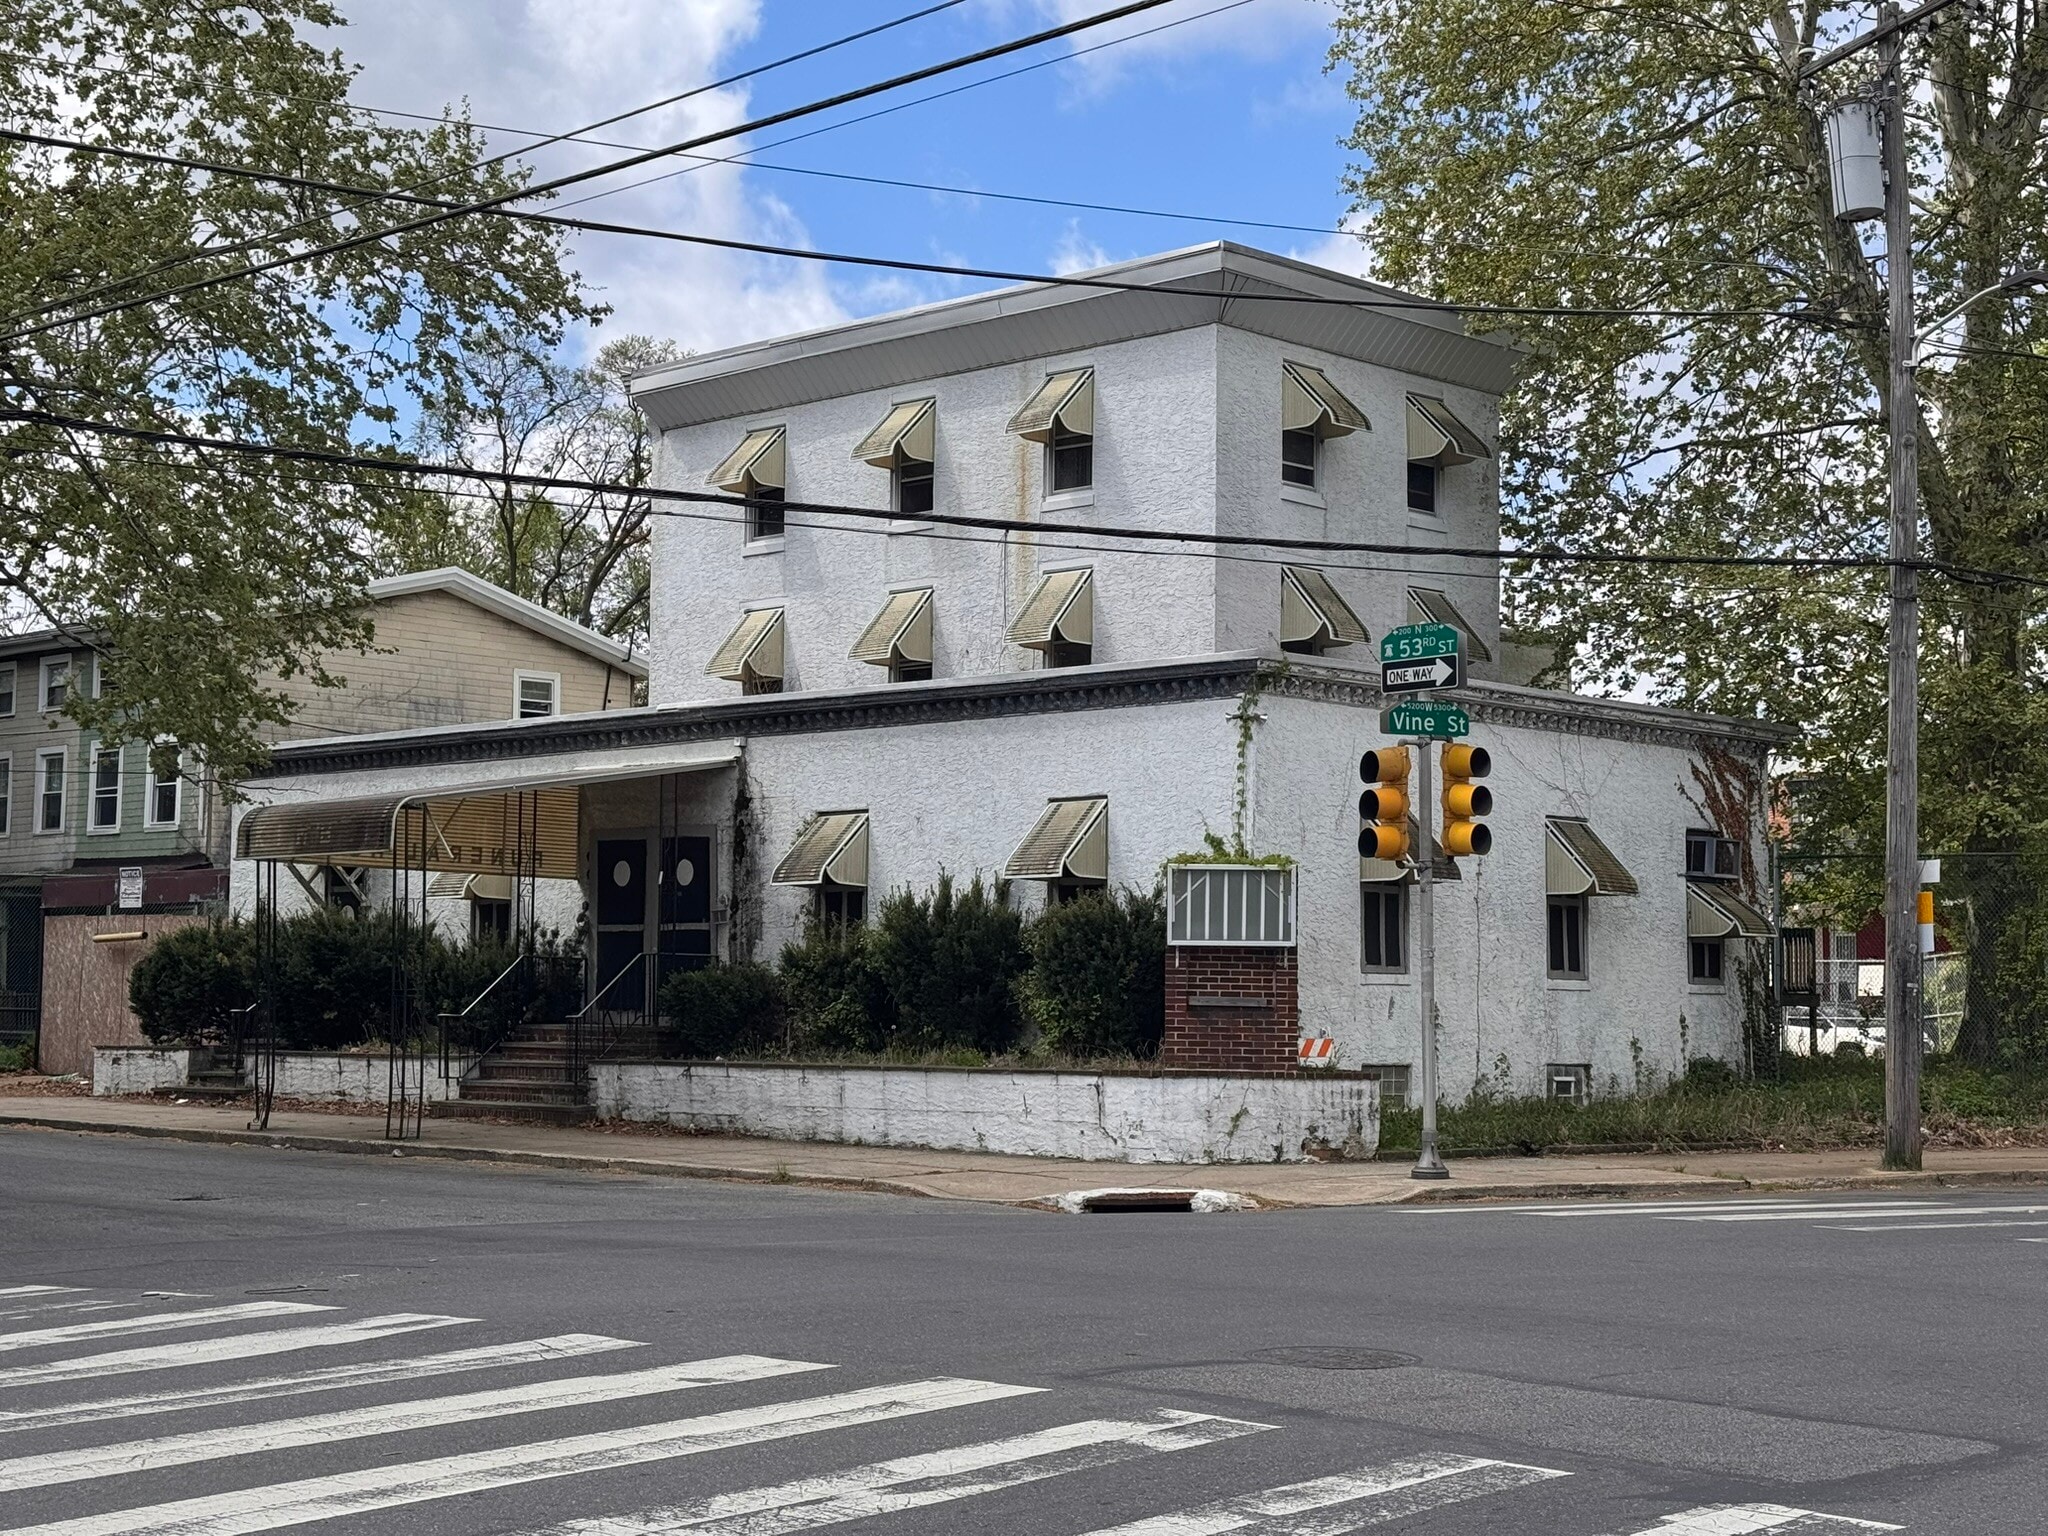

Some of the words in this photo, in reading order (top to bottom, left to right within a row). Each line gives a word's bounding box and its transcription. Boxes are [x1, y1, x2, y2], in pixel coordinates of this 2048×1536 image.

[1415, 625, 1422, 634] N
[1425, 624, 1438, 632] 300
[1399, 637, 1436, 658] 53RD
[1438, 639, 1455, 653] ST
[1389, 669, 1409, 684] ONE
[1412, 667, 1434, 681] WAY
[1425, 702, 1433, 711] W
[1392, 711, 1435, 731] Vine
[1447, 715, 1466, 733] St
